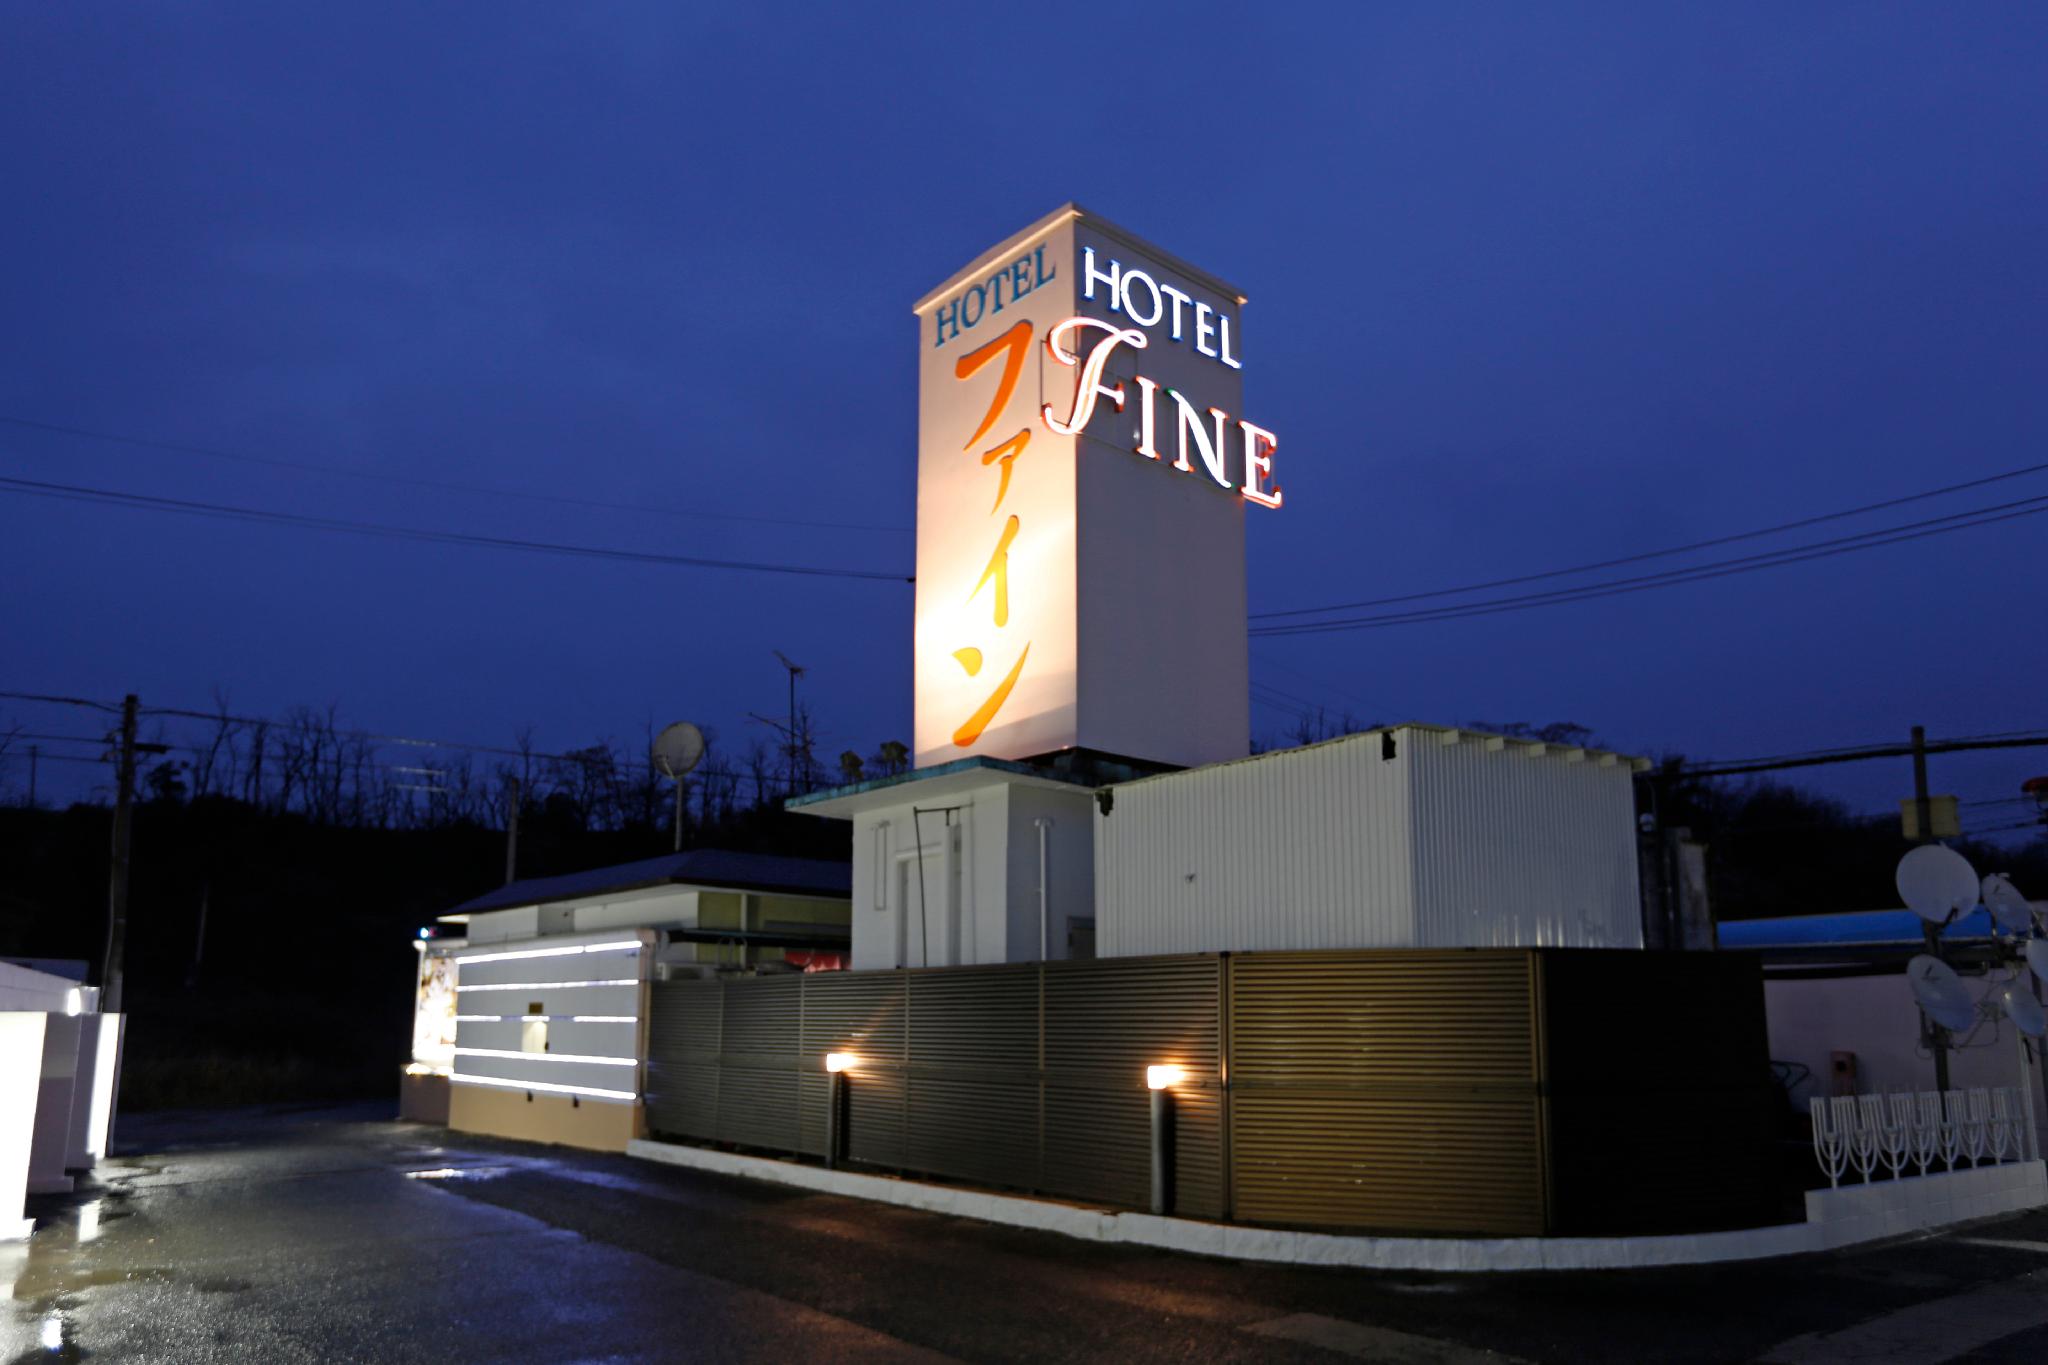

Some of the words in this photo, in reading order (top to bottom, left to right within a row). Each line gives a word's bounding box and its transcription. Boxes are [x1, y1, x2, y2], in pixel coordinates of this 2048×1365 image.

[935, 242, 1056, 348] HOTEL
[1083, 246, 1242, 369] HOTEL
[1042, 316, 1283, 508] FINE
[952, 319, 1033, 748] ファイン
